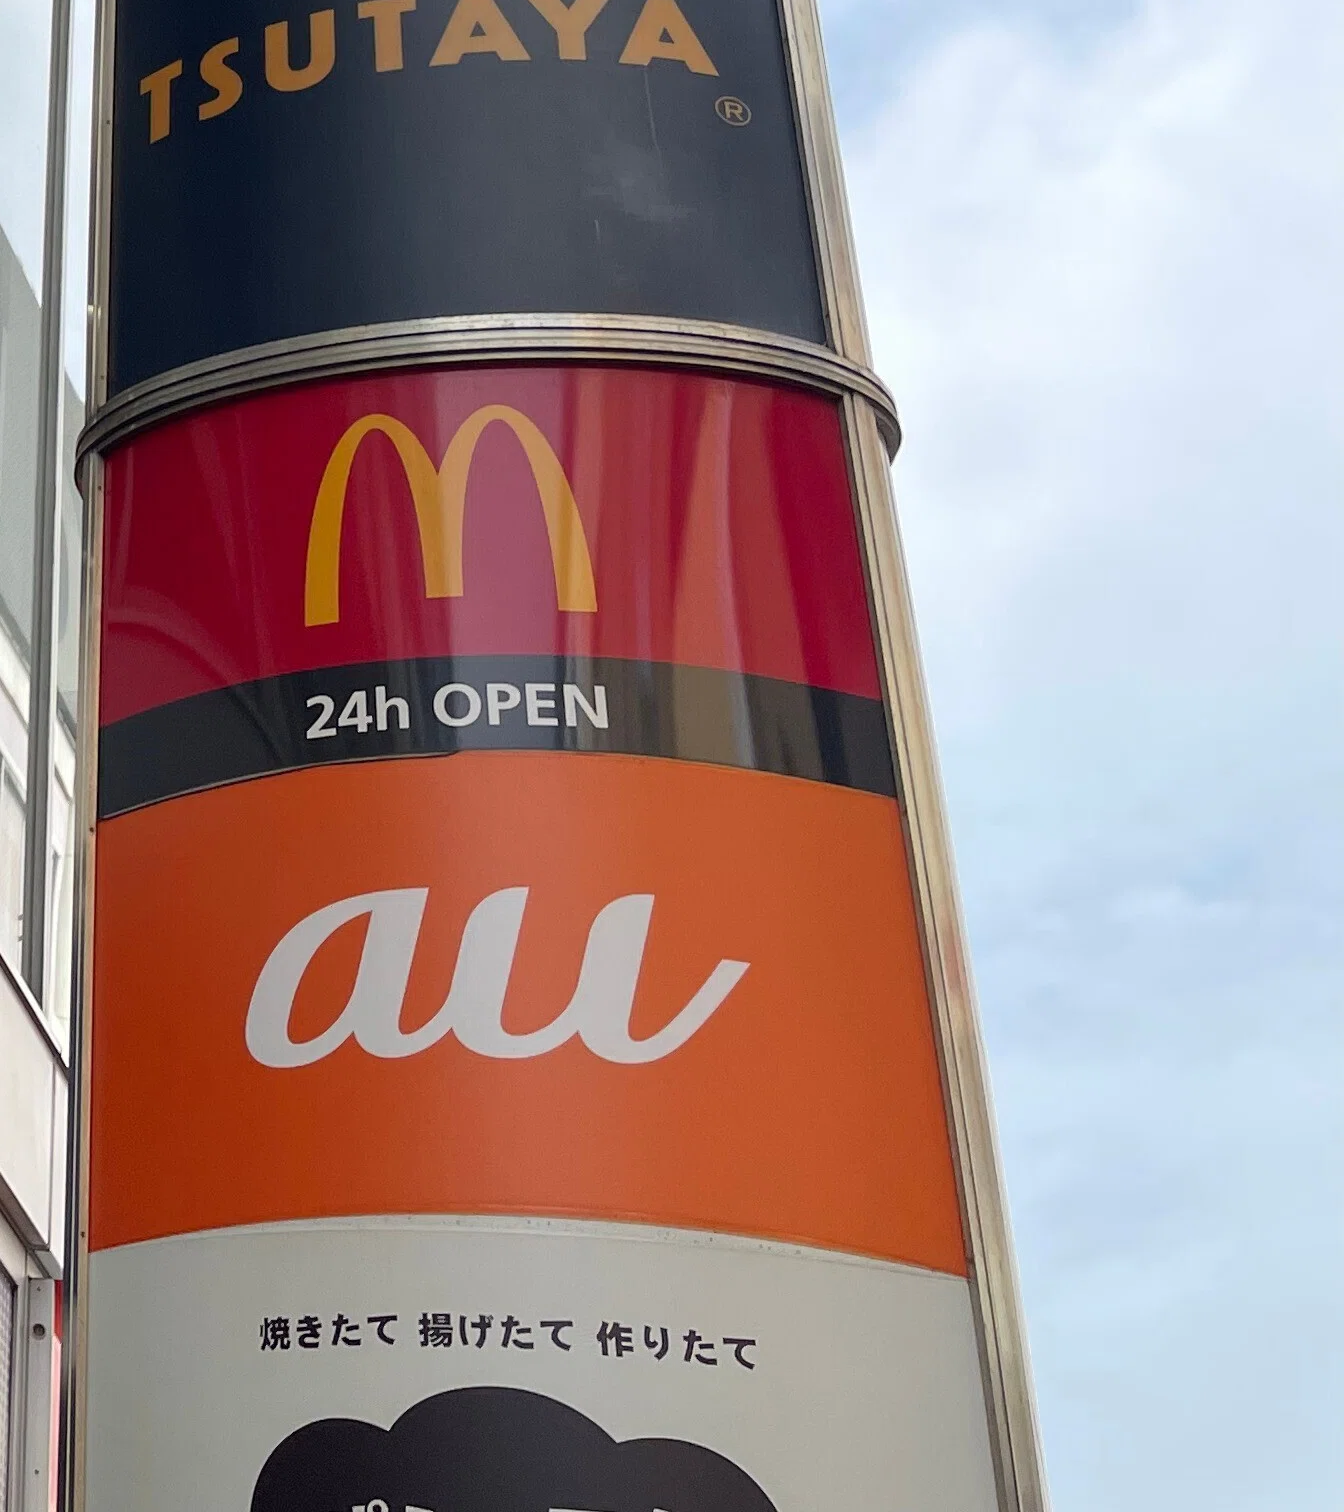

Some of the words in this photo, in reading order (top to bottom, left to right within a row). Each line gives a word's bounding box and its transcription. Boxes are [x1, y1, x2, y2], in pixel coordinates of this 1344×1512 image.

[305, 686, 410, 740] 24h
[433, 682, 610, 730] OPEN
[244, 886, 752, 1069] au
[259, 1313, 397, 1353] 焼きたて
[419, 1313, 574, 1351] 揚げたて
[596, 1321, 759, 1370] 作りたて
